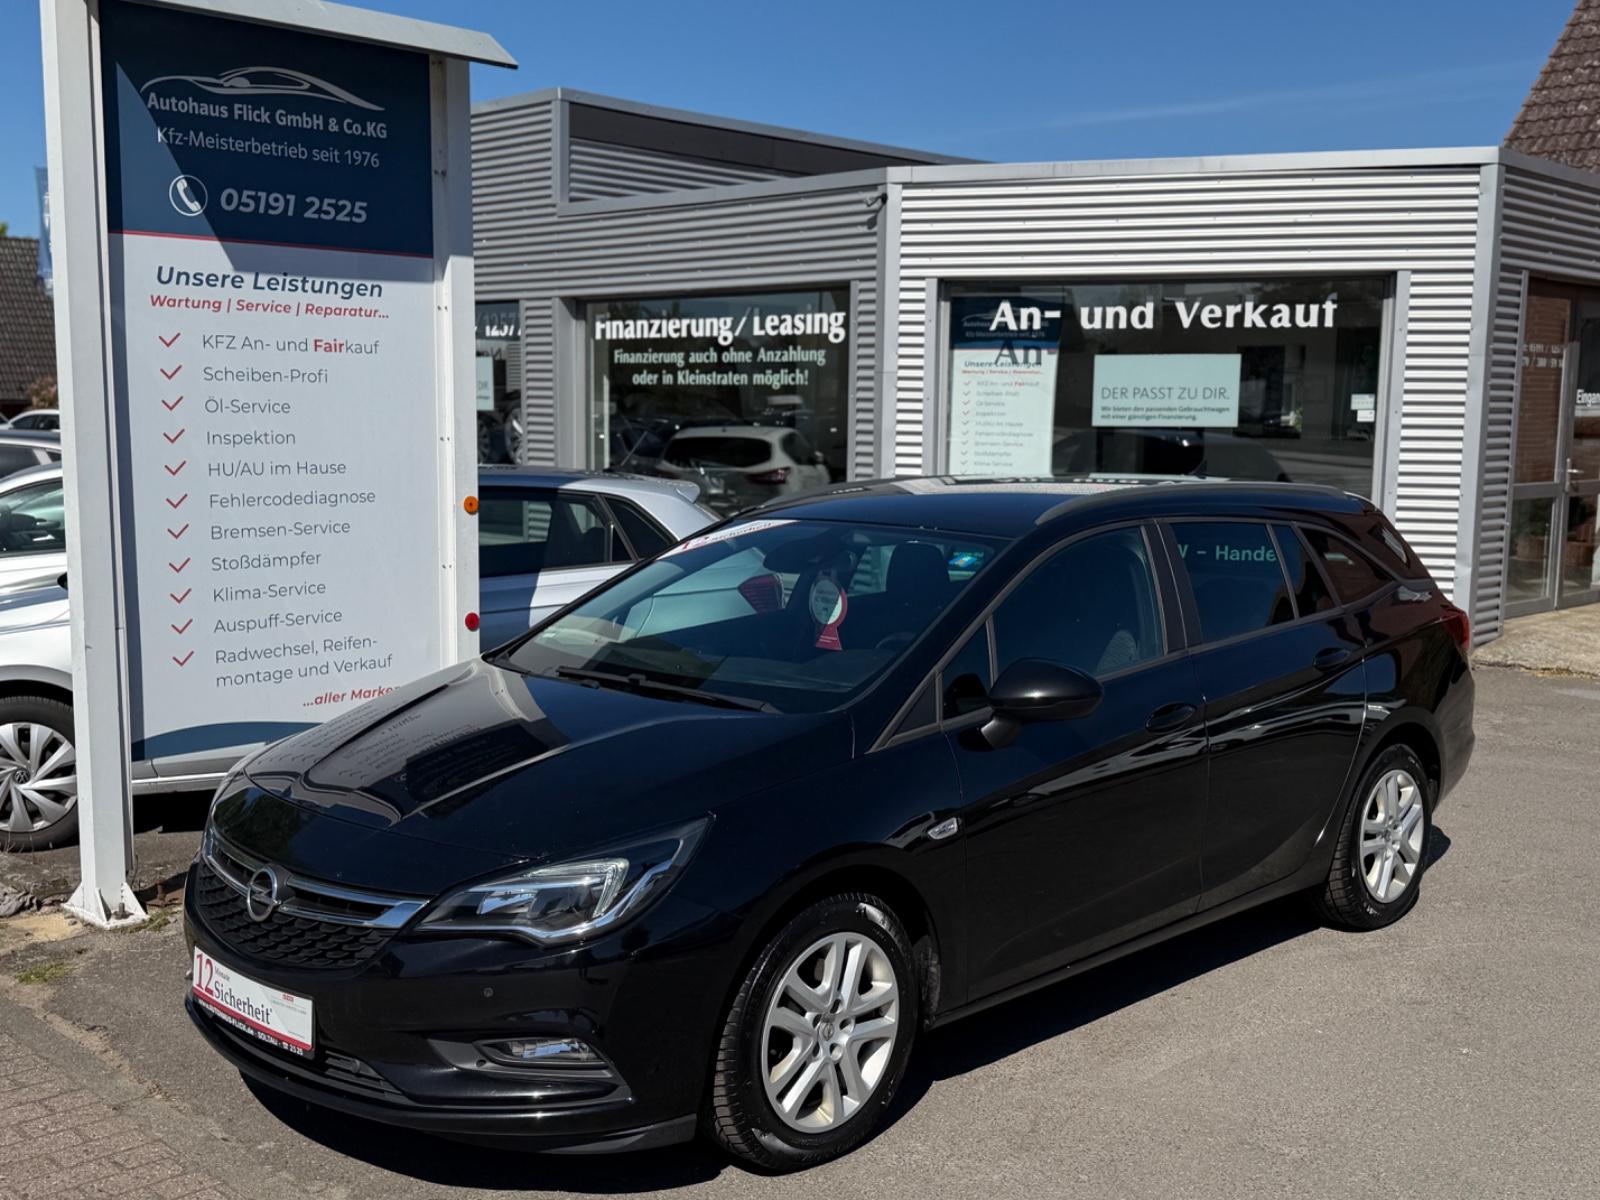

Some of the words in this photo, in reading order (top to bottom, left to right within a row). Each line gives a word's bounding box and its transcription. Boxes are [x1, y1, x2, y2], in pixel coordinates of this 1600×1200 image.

[147, 92, 229, 118] Autohaus
[234, 103, 271, 123] Flick
[275, 109, 324, 132] GmbH
[328, 118, 339, 132] &
[343, 119, 387, 138] Co.KG
[157, 126, 308, 159] Kfz-Meisterbetrieb
[312, 147, 340, 163] seit
[345, 150, 380, 168] 1976
[220, 188, 296, 216] 05191
[304, 196, 368, 223] 2525
[157, 266, 244, 289] Unsere
[253, 271, 383, 300] Leistungen
[150, 294, 222, 312] Wartung
[236, 299, 292, 314] Service
[305, 303, 390, 319] Reparatur...
[990, 300, 1061, 331] An-
[1080, 296, 1154, 329] und
[1175, 294, 1337, 329] Verkauf
[202, 334, 237, 350] KFZ
[241, 336, 271, 351] An-
[276, 338, 308, 352] und
[313, 339, 380, 355] Fairkauf
[614, 349, 685, 368] Finanzierung
[689, 347, 717, 363] auch
[722, 347, 752, 363] ohne
[757, 345, 826, 366] Anzahlung
[203, 366, 329, 383] Scheiben-Profi
[632, 370, 658, 385] oder
[662, 370, 673, 385] in
[753, 369, 809, 389] möglich!
[1101, 386, 1128, 400] DER
[1133, 386, 1174, 400] PASST
[1177, 386, 1198, 400] ZU
[1202, 386, 1231, 400] DIR.
[204, 395, 291, 414] Öl-Service
[206, 430, 296, 448] Inspektion
[208, 460, 265, 478] HU/AU
[270, 460, 291, 475] im
[297, 461, 346, 475] Hause
[209, 490, 376, 509] Fehlercodediagnose
[210, 520, 351, 540] Bremsen-Service
[211, 551, 322, 571] Stoßdämpfer
[213, 581, 326, 602] Klima-Service
[213, 610, 343, 633] Auspuff-Service
[215, 640, 318, 664] Radwechsel,
[323, 636, 378, 653] Reifen-
[216, 667, 294, 688] montage
[298, 661, 330, 677] und
[334, 653, 393, 674] Verkauf
[351, 685, 400, 700] Marke
[196, 953, 214, 997] 12
